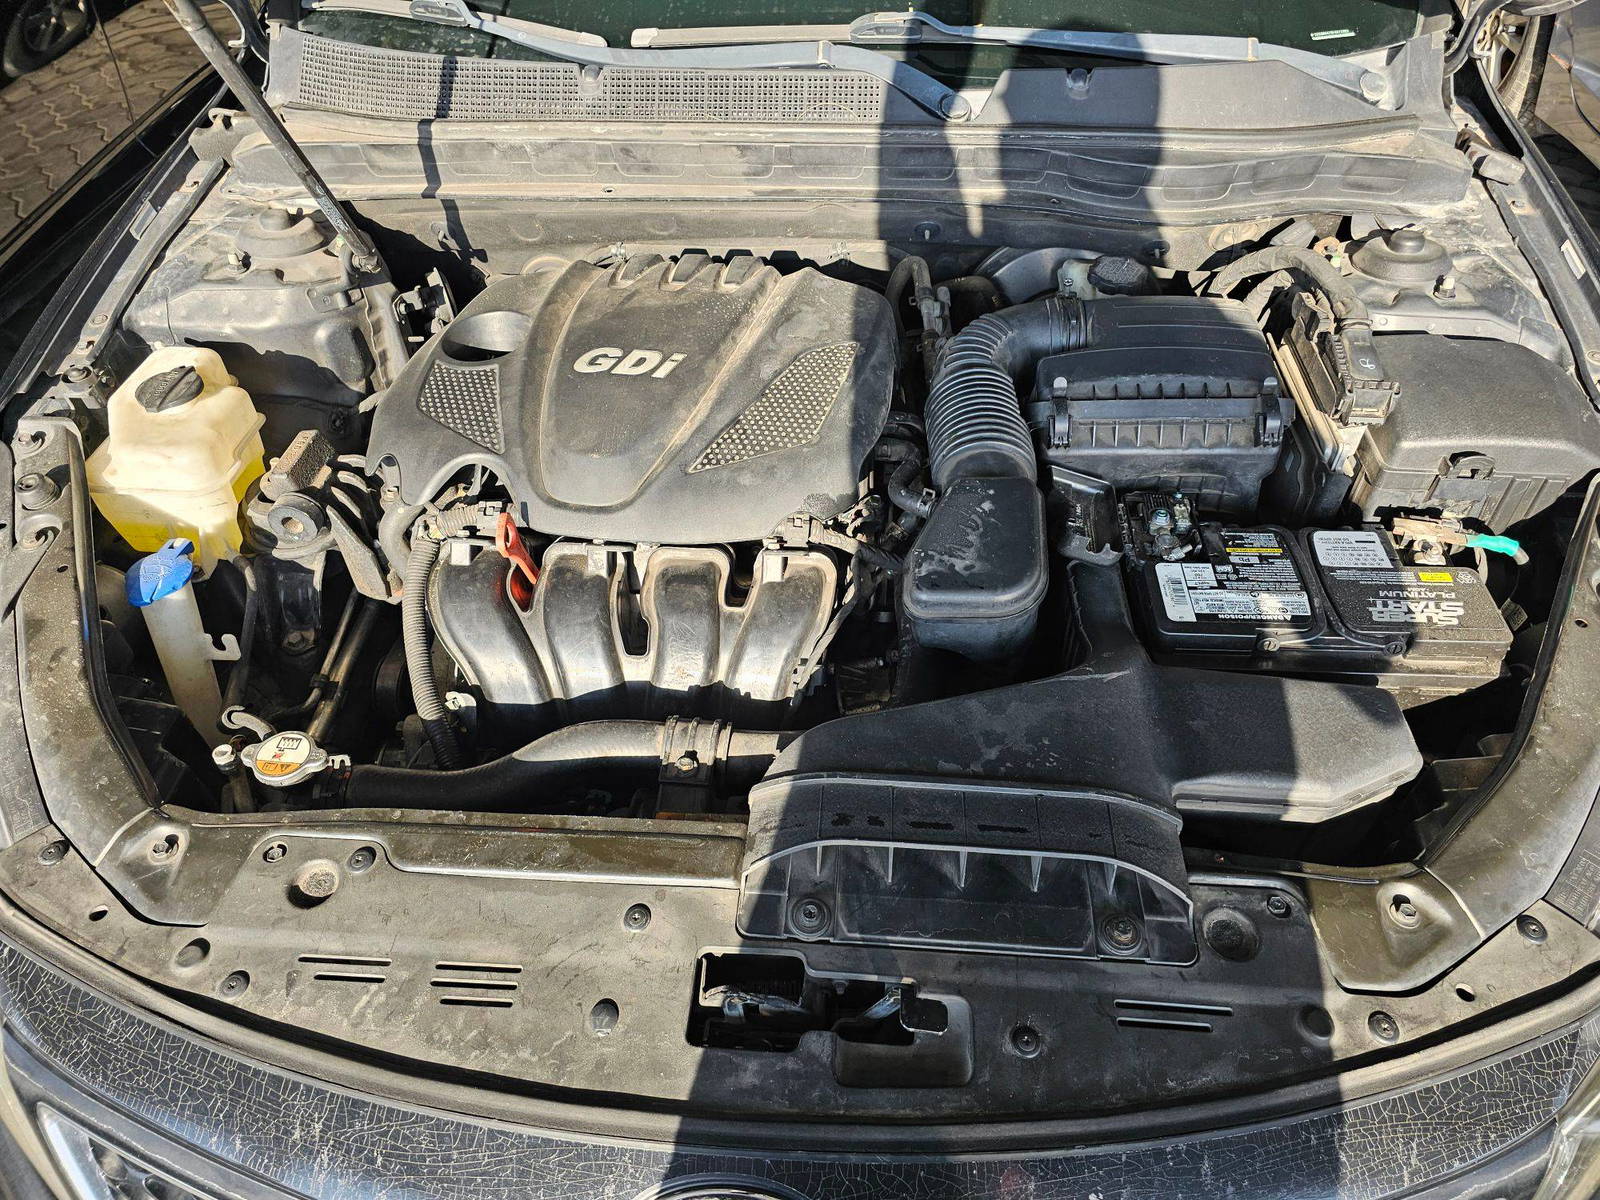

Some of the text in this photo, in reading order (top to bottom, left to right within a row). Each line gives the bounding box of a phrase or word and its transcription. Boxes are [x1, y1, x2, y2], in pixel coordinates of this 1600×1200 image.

[573, 347, 688, 379] GDi
[1379, 590, 1456, 599] PLATINUM
[1367, 600, 1464, 616] START
[1371, 611, 1459, 627] SUPER
